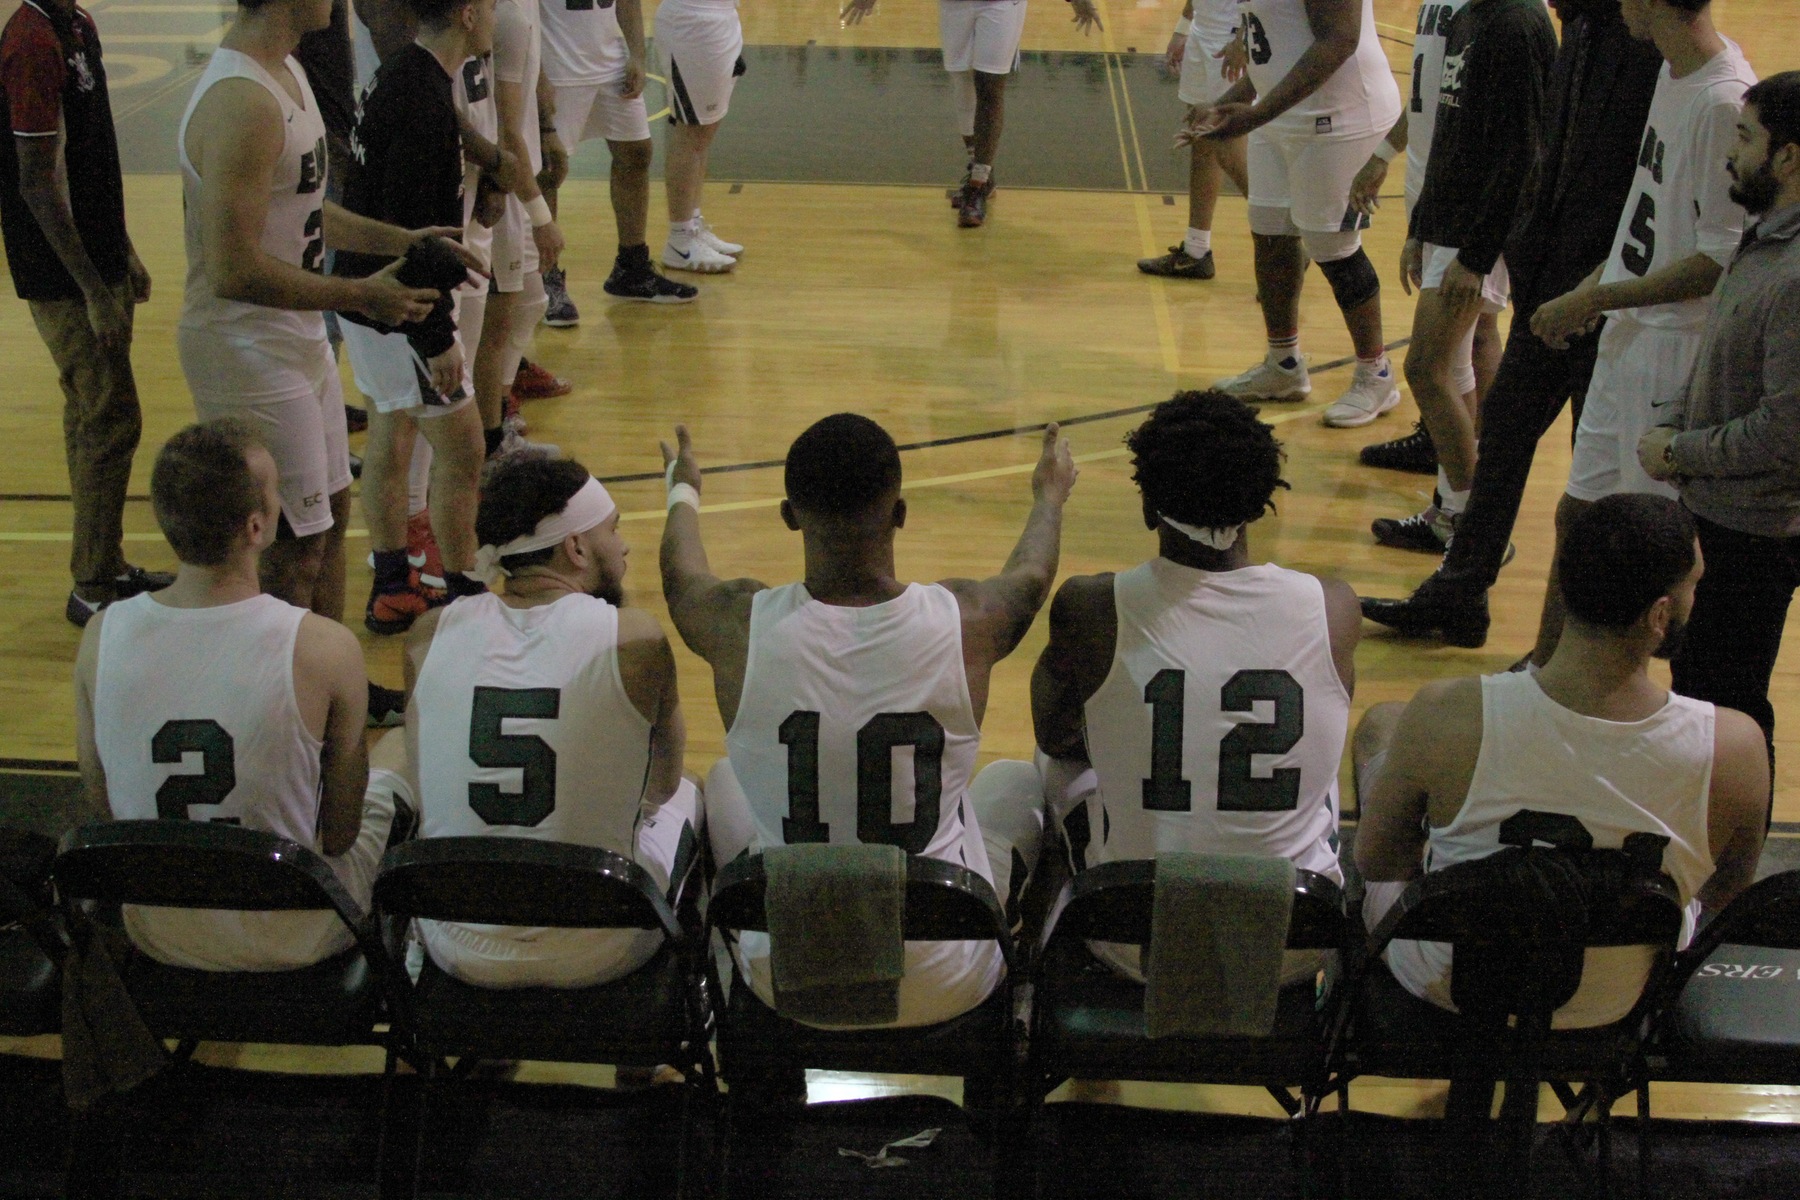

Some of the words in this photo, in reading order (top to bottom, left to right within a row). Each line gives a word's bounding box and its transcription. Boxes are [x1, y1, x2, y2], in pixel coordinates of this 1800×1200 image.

[1621, 191, 1655, 277] 5
[303, 492, 324, 508] EC
[151, 718, 236, 821] 2
[467, 685, 561, 827] 5
[777, 710, 946, 854] 10
[1142, 668, 1304, 812] 12
[1697, 963, 1800, 980] ERS
